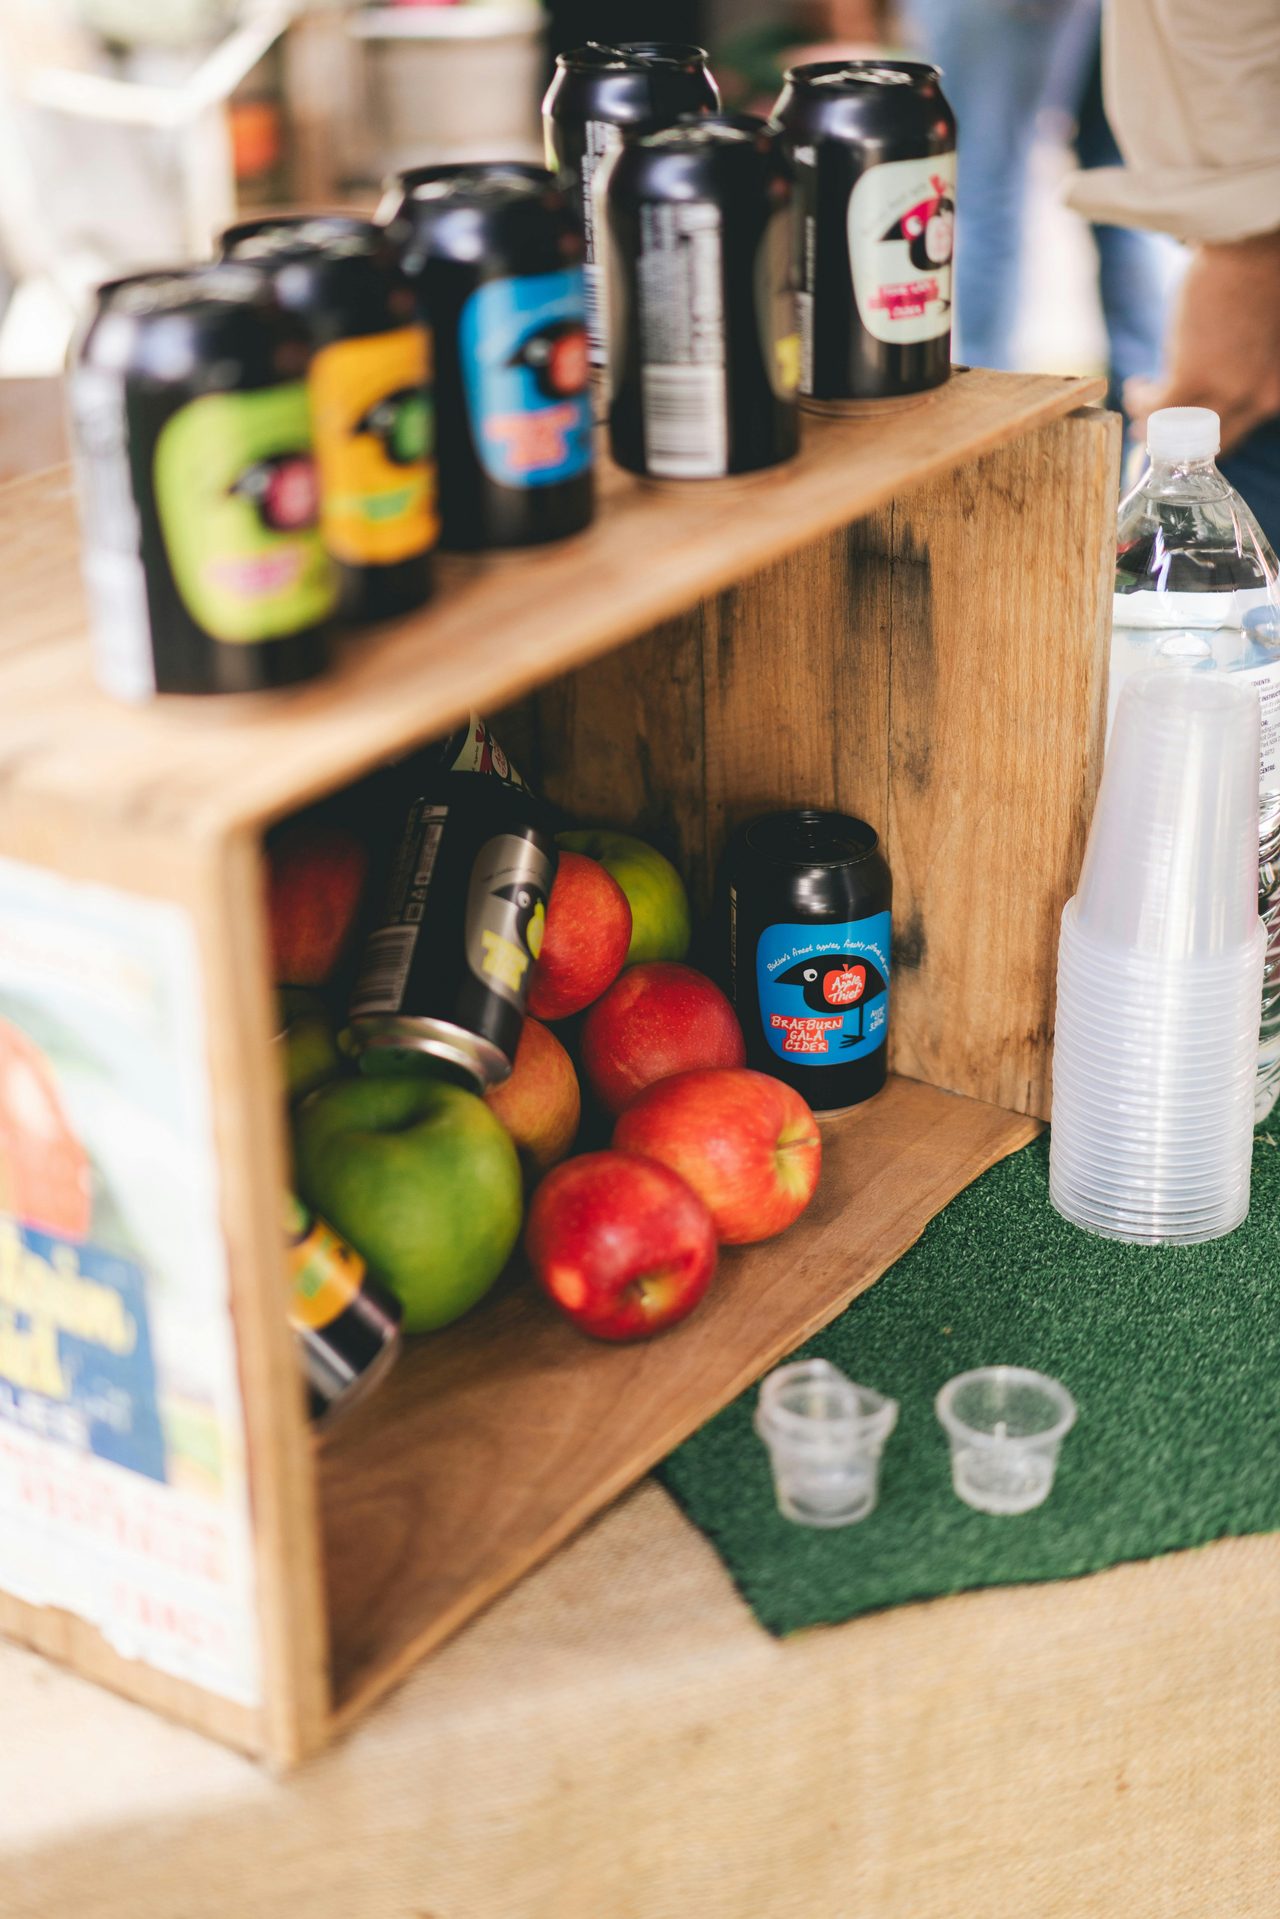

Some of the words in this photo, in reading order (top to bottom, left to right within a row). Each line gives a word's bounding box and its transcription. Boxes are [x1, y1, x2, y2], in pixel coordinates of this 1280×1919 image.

[832, 974, 863, 990] Apple
[828, 986, 860, 1002] Thief
[771, 1015, 843, 1030] BRAEBURN
[789, 1030, 823, 1041] GALA
[785, 1040, 827, 1051] CIDER
